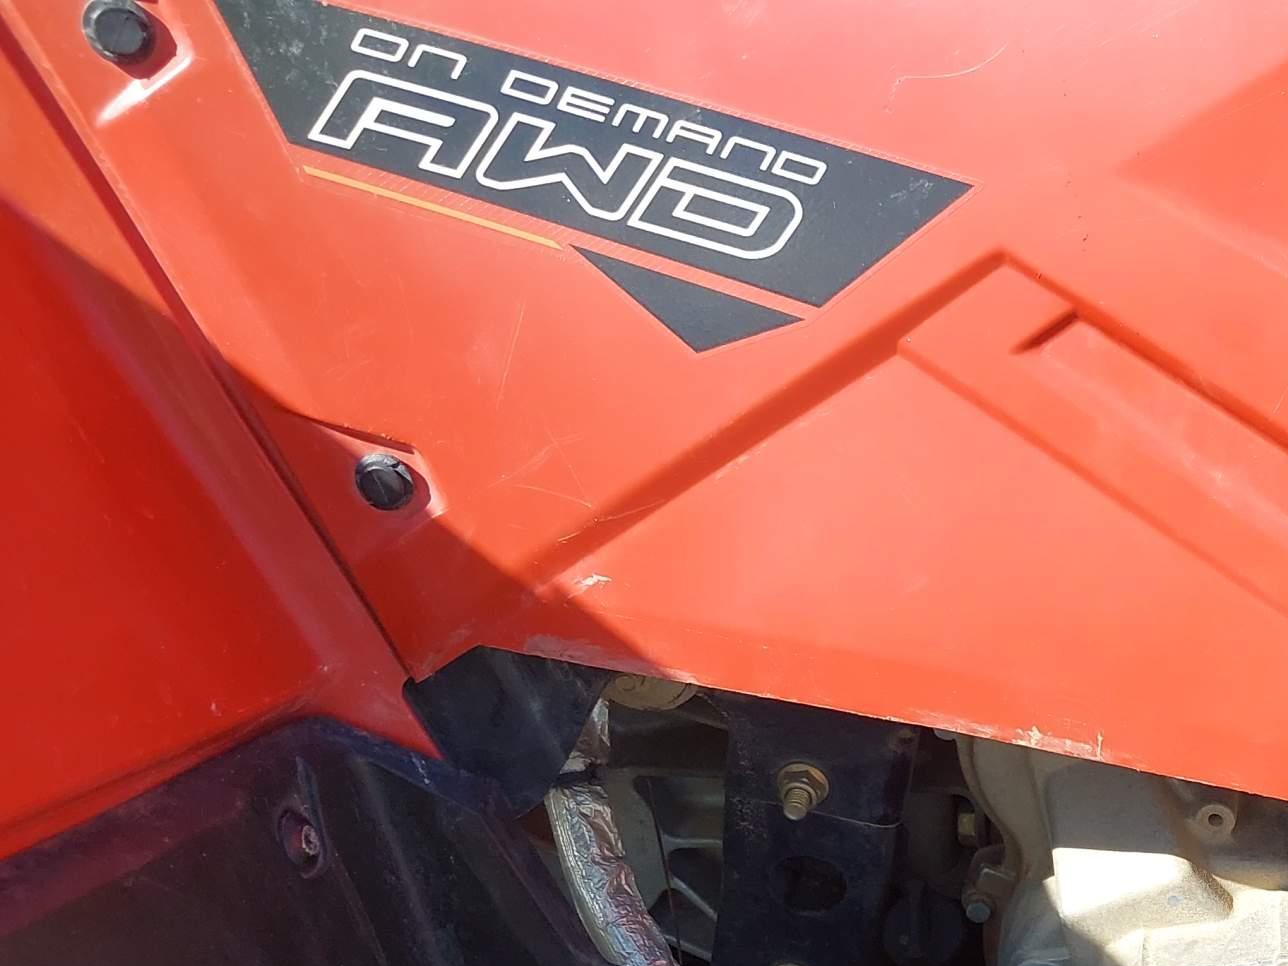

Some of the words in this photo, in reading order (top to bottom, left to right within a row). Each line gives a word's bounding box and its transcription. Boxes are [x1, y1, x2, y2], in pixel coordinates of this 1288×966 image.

[306, 69, 804, 260] AWD
[350, 27, 468, 80] ON
[500, 69, 828, 185] DEMAND
